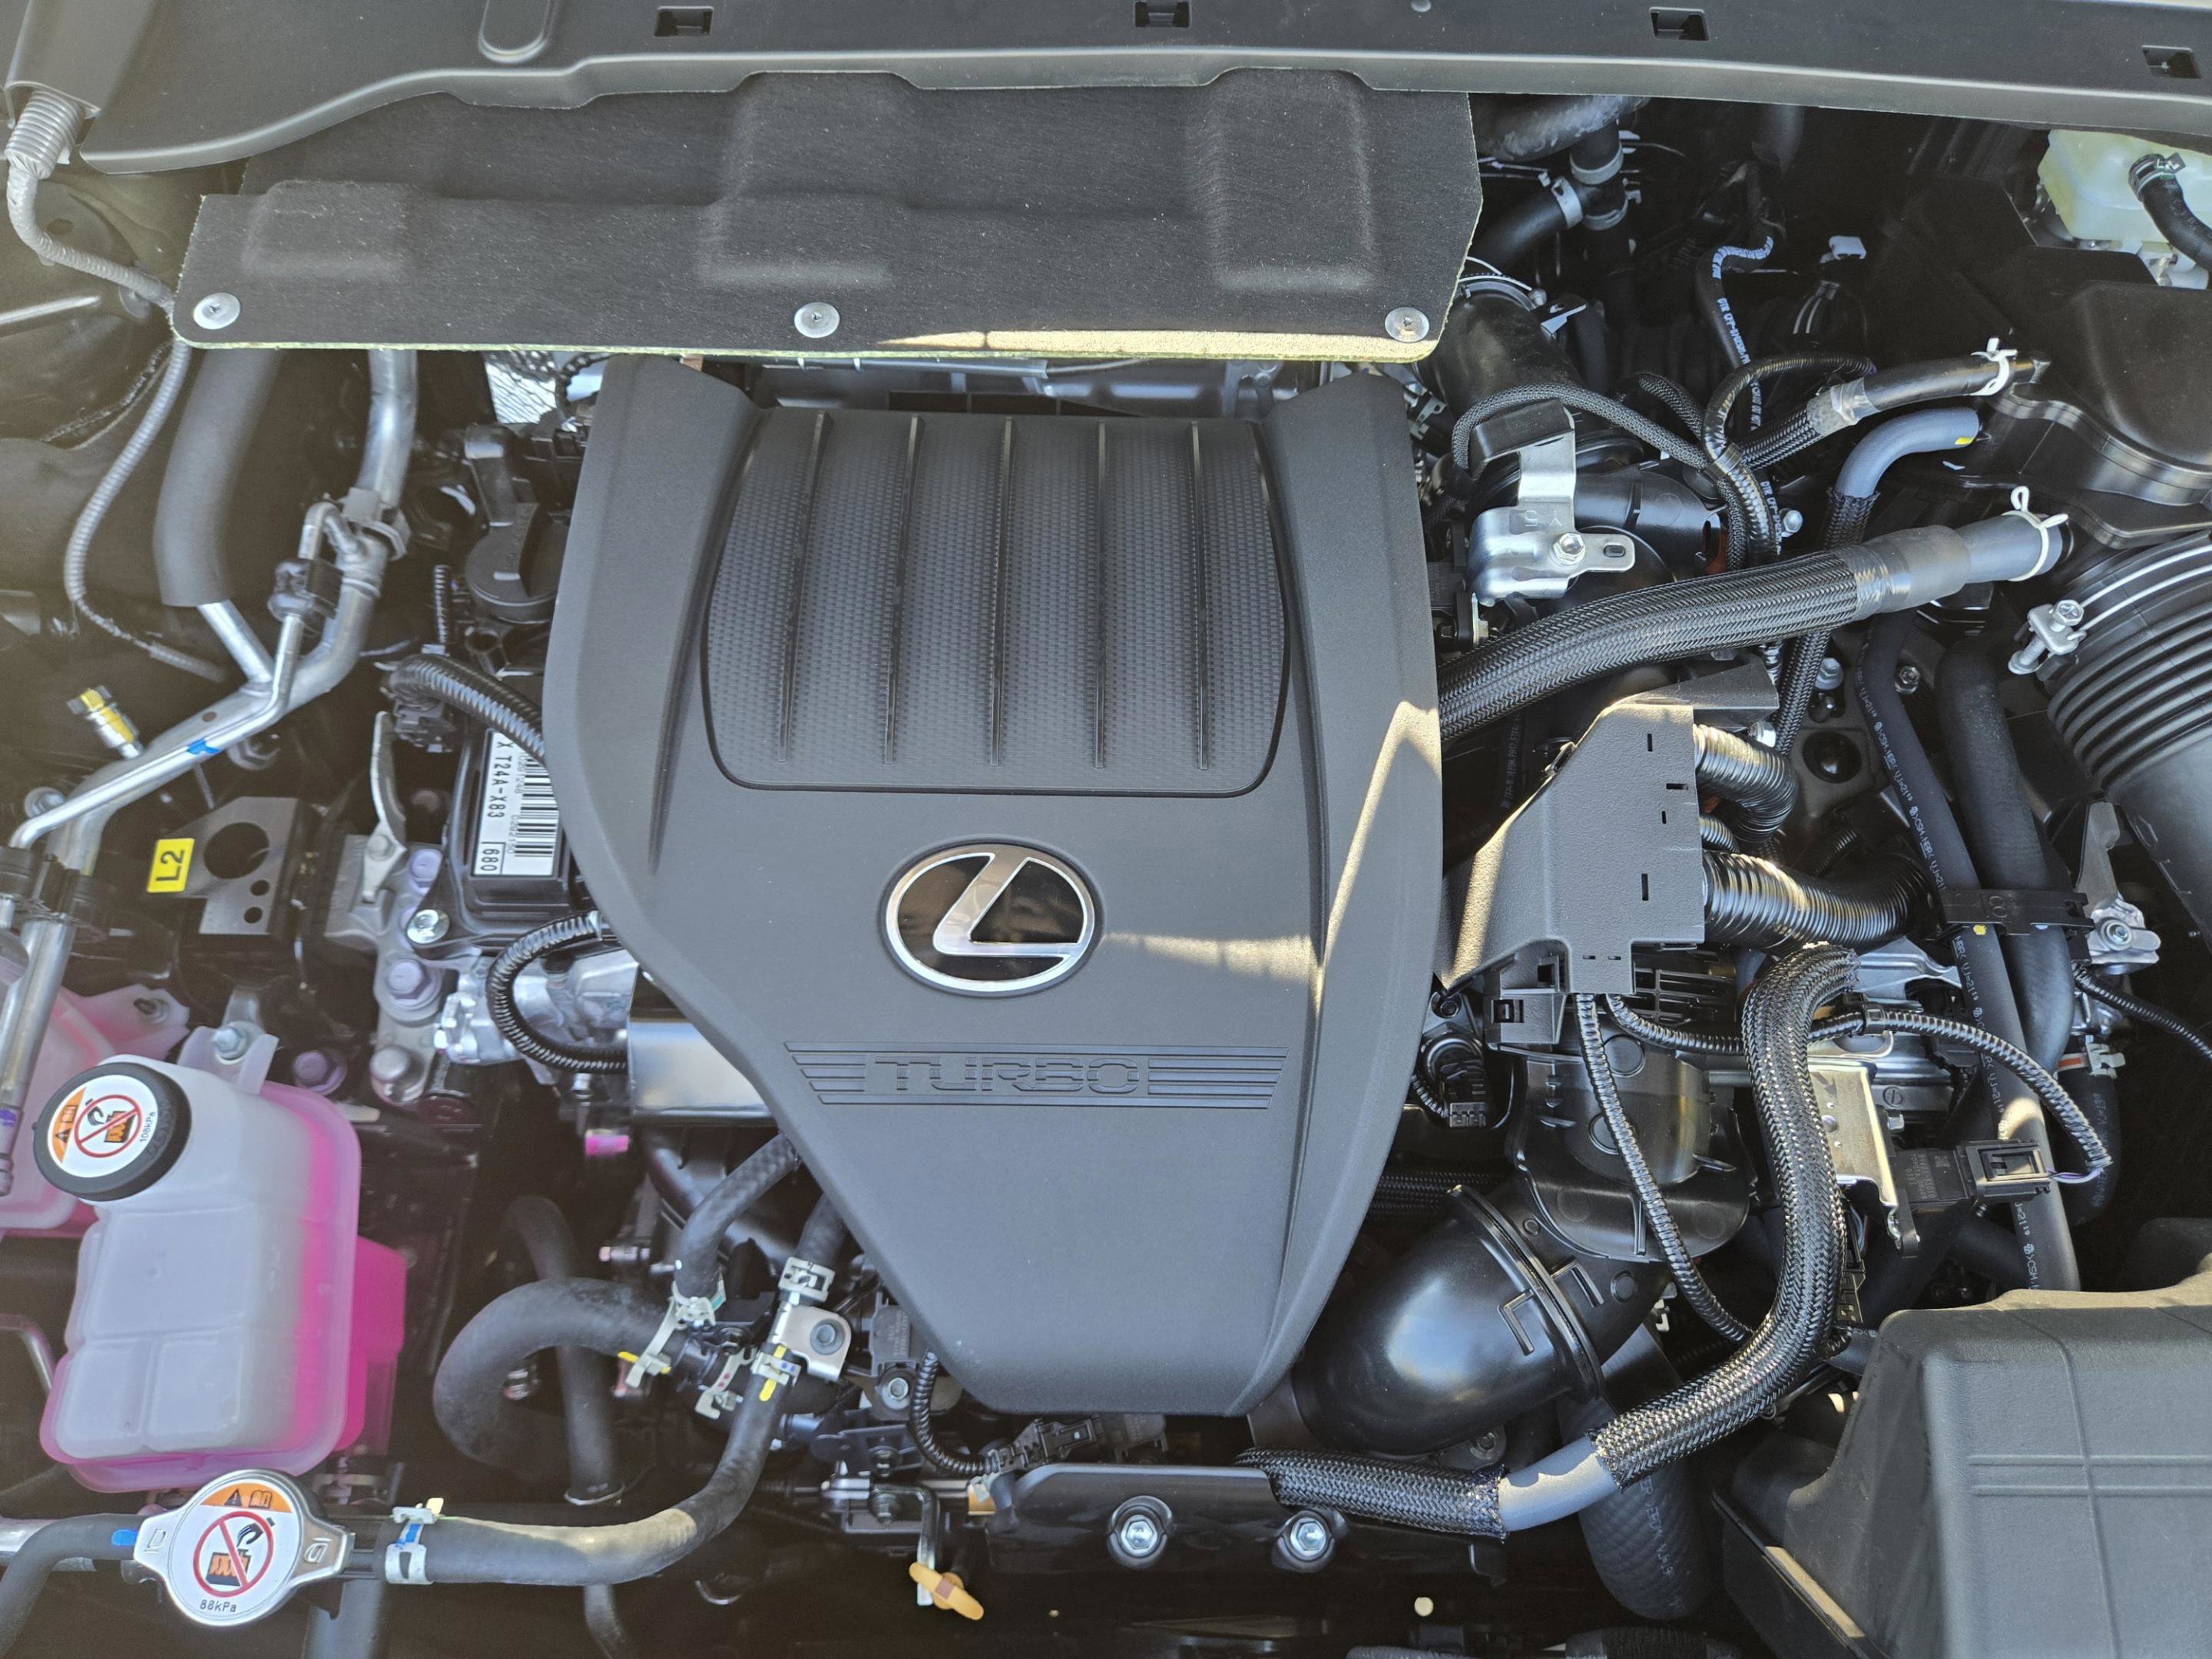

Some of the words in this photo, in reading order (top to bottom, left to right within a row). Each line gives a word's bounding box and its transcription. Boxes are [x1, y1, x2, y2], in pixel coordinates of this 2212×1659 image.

[488, 755, 512, 818] T24A-X83
[156, 849, 185, 882] L2
[480, 848, 500, 872] 680
[873, 1055, 1141, 1095] TURBO
[200, 1599, 237, 1613] 88kPa
